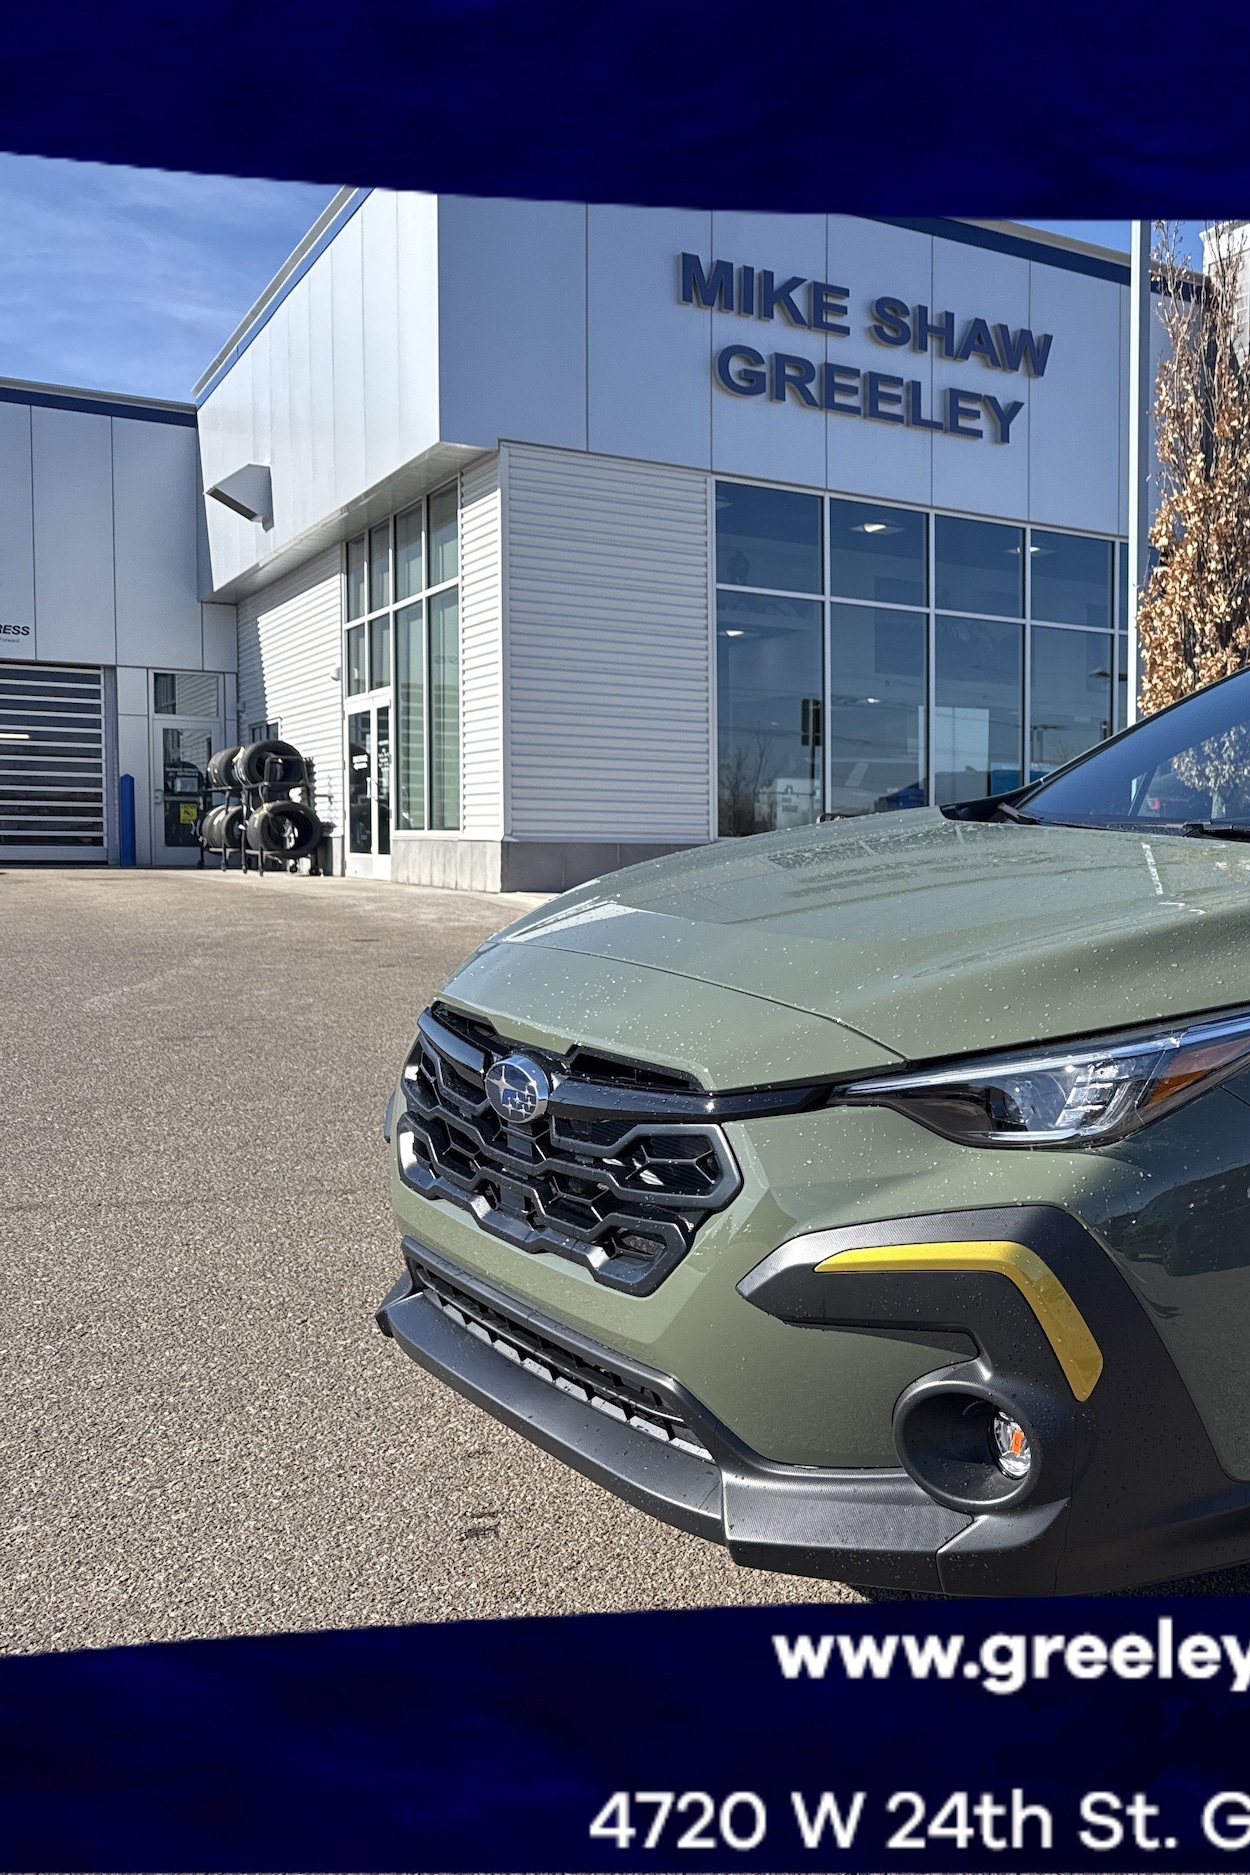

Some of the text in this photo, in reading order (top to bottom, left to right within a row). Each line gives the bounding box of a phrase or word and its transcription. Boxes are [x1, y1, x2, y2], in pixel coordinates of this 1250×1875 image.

[678, 252, 1054, 378] MIKE SHAW
[713, 344, 1025, 445] GREELEY
